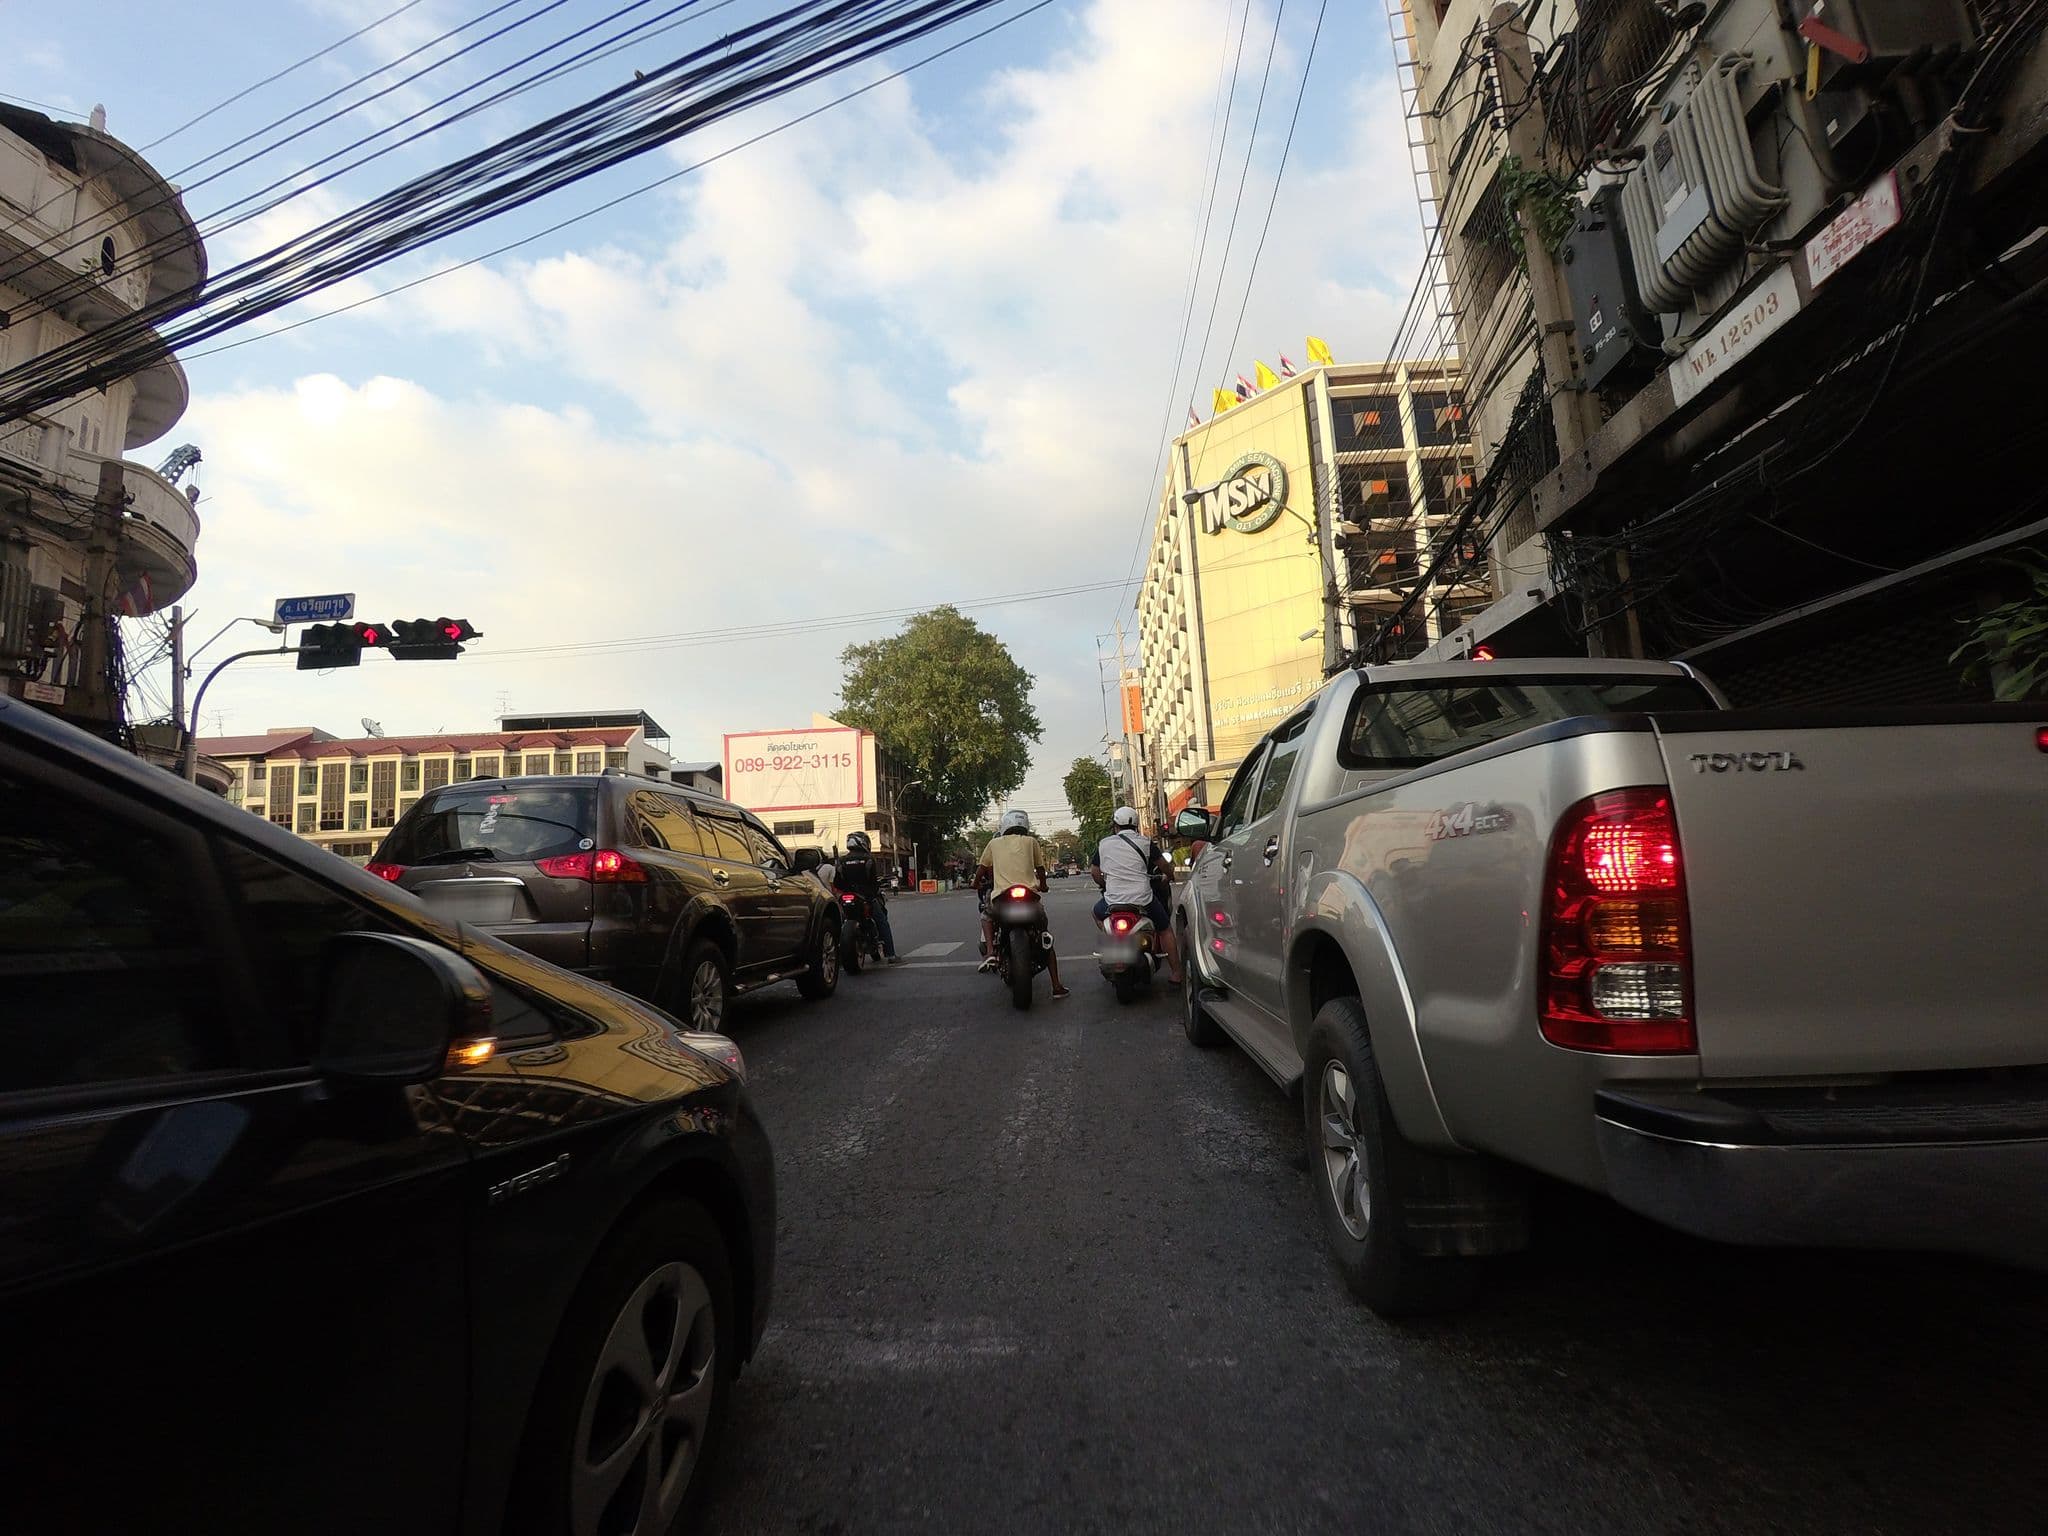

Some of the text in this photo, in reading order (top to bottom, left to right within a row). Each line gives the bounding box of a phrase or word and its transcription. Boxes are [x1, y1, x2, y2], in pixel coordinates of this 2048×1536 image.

[1720, 291, 1780, 355] 12503
[1230, 458, 1245, 473] MIN
[1247, 453, 1264, 462] SEN
[1203, 472, 1271, 534] MSM
[735, 753, 851, 773] 089-922-3115
[1689, 752, 1805, 773] TOYOTA
